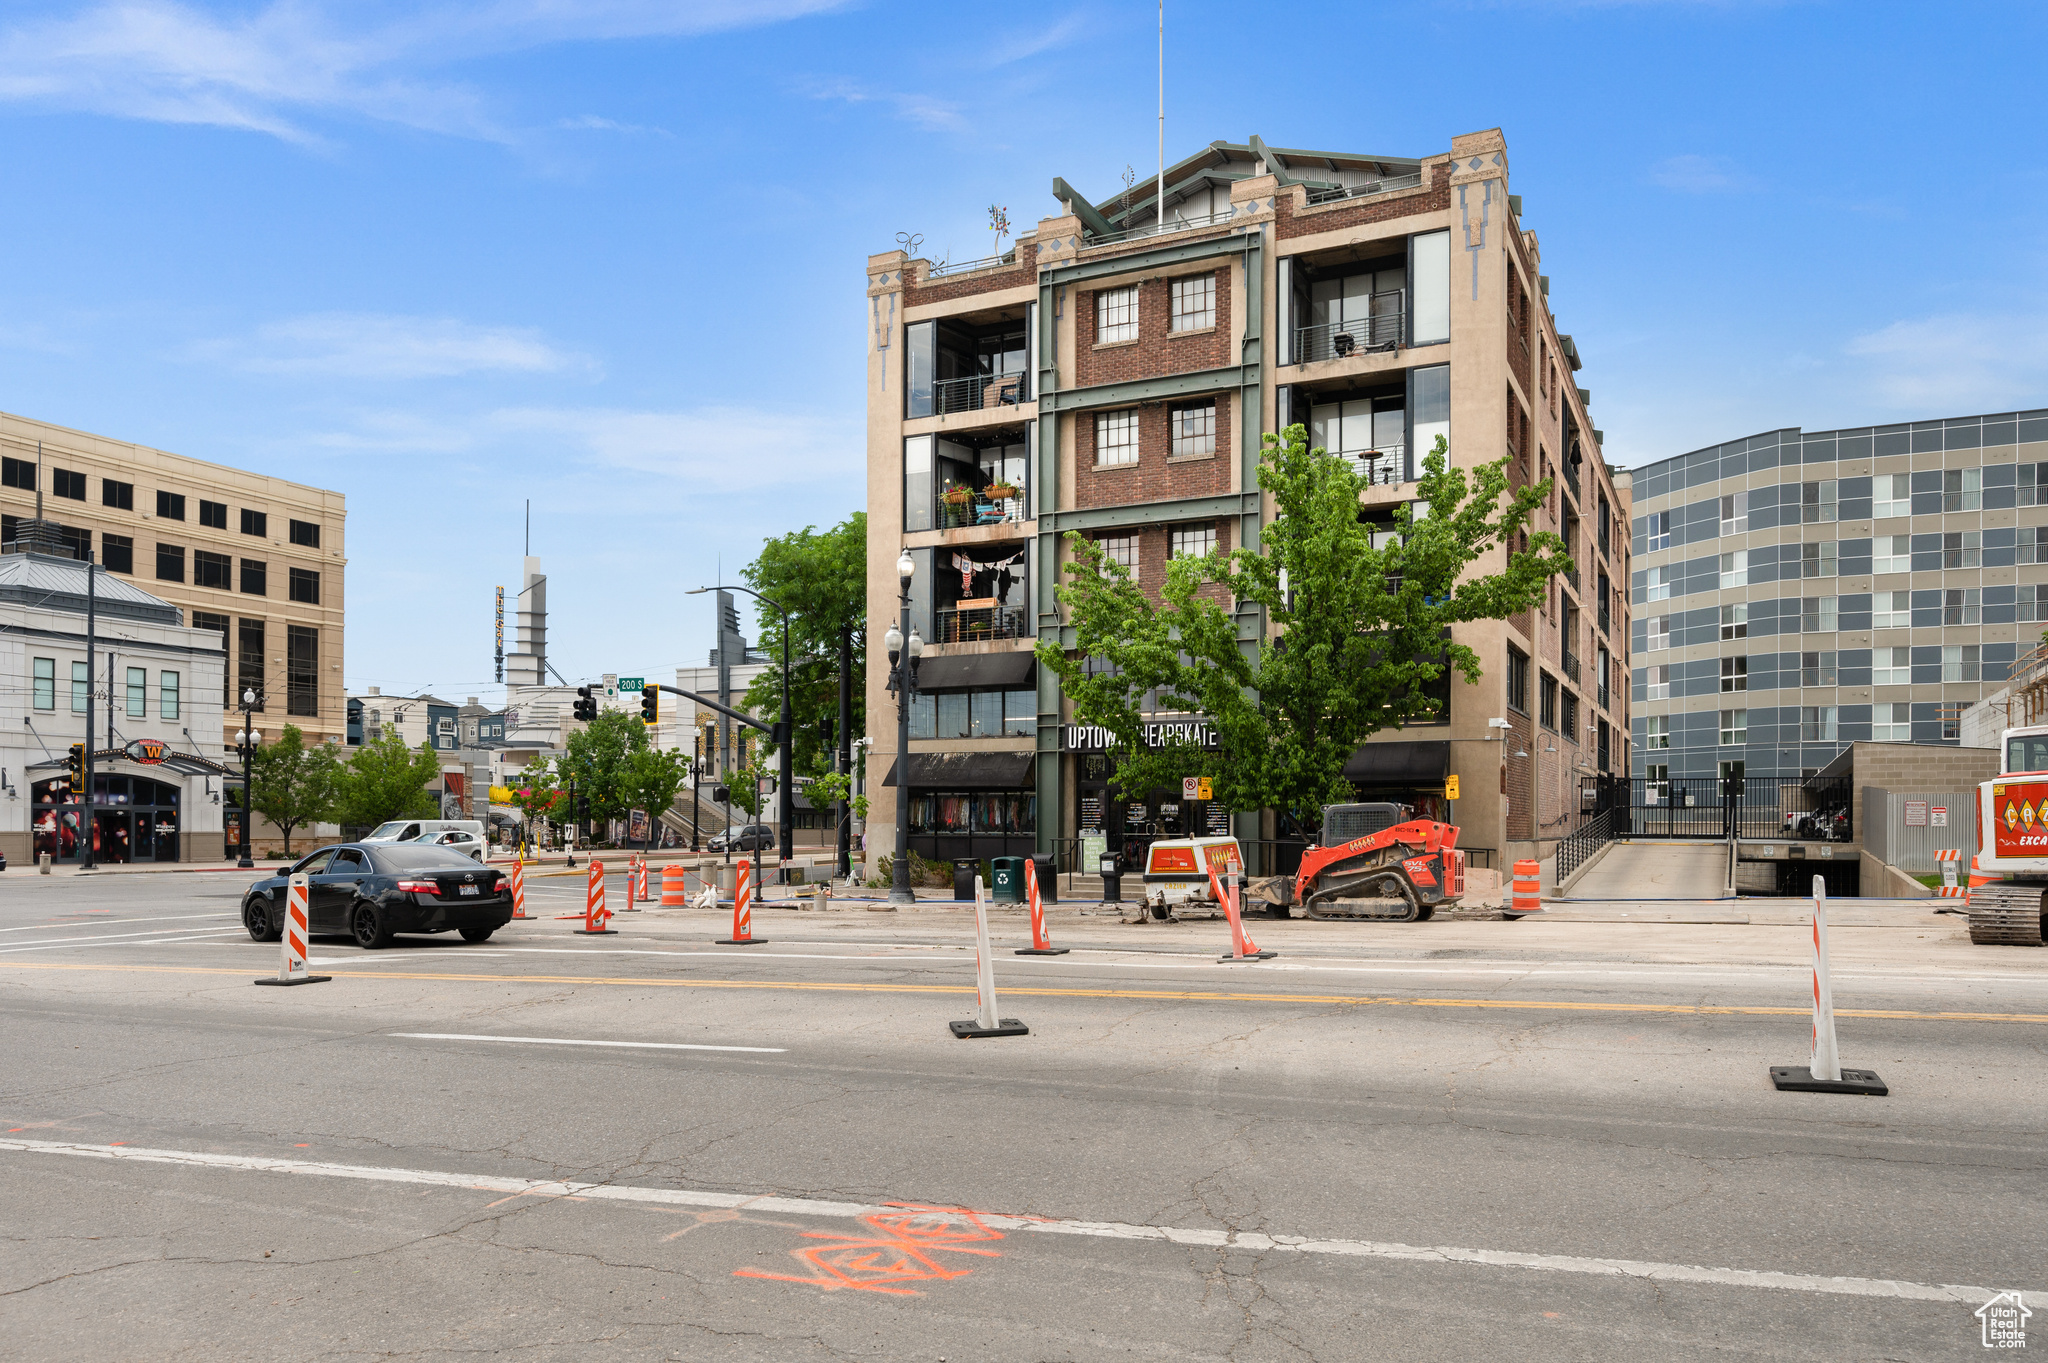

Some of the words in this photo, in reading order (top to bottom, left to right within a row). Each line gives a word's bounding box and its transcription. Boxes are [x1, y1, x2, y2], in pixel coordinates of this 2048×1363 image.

[496, 585, 504, 614] The
[621, 680, 636, 690] 200
[637, 680, 643, 690] S
[1068, 726, 1128, 748] UPTOW
[1135, 724, 1217, 747] HEAPSKATE
[145, 746, 163, 758] W
